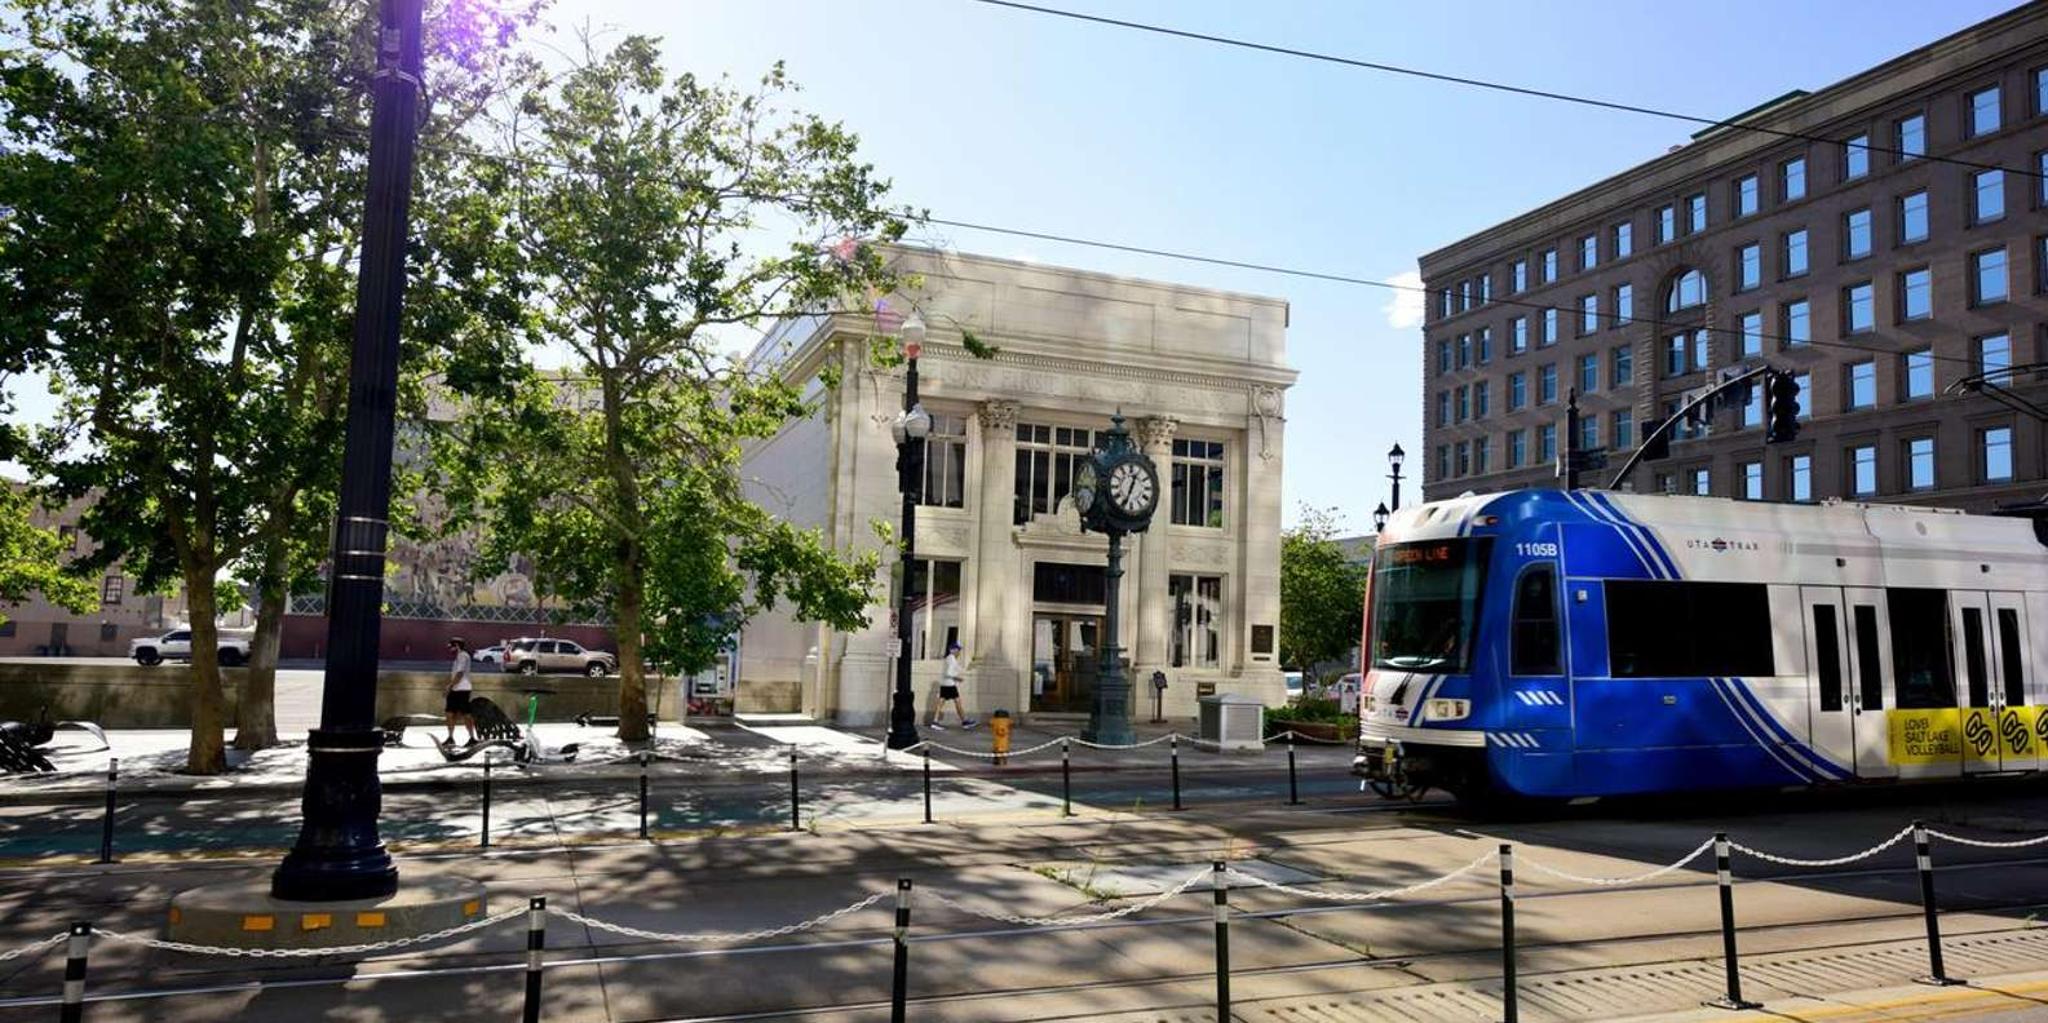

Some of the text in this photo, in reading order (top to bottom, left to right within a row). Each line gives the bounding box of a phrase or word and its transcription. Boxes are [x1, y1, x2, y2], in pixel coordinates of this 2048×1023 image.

[1516, 543, 1557, 556] 1105B
[1687, 540, 1709, 549] UTA
[1905, 730, 1949, 743] SALT LAKE
